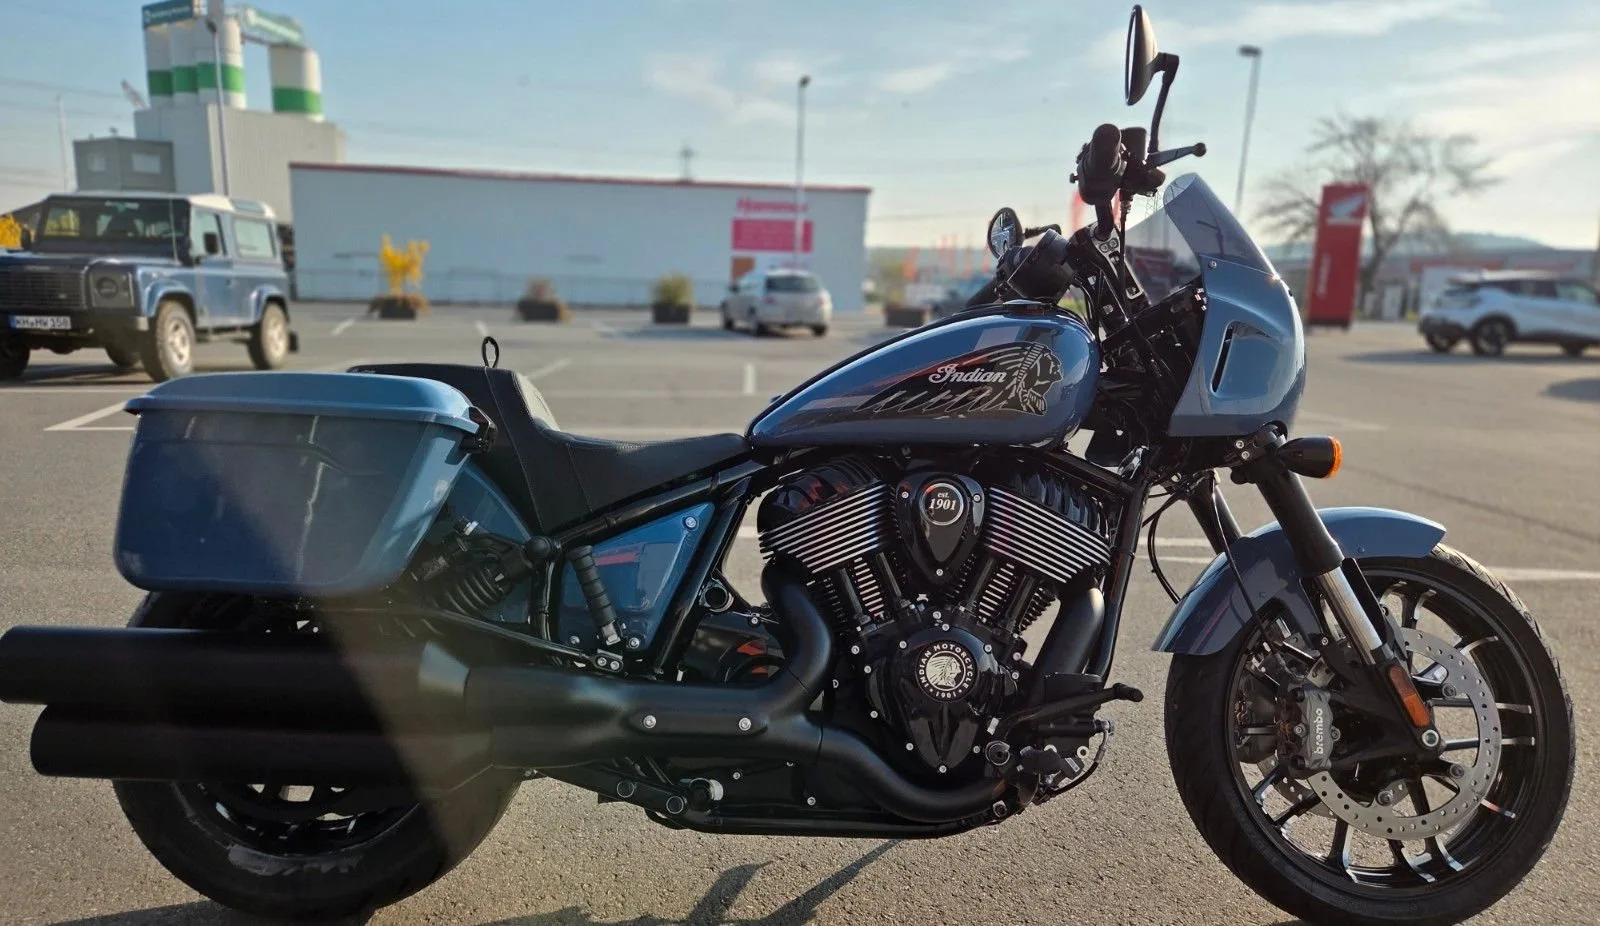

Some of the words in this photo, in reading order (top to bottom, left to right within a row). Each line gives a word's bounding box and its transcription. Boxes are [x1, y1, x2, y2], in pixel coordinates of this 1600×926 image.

[928, 363, 1007, 383] Indian
[929, 498, 956, 510] 1901
[919, 650, 932, 687] INDIAN
[933, 643, 973, 689] MOTORCYCLE
[1313, 708, 1324, 754] brembo
